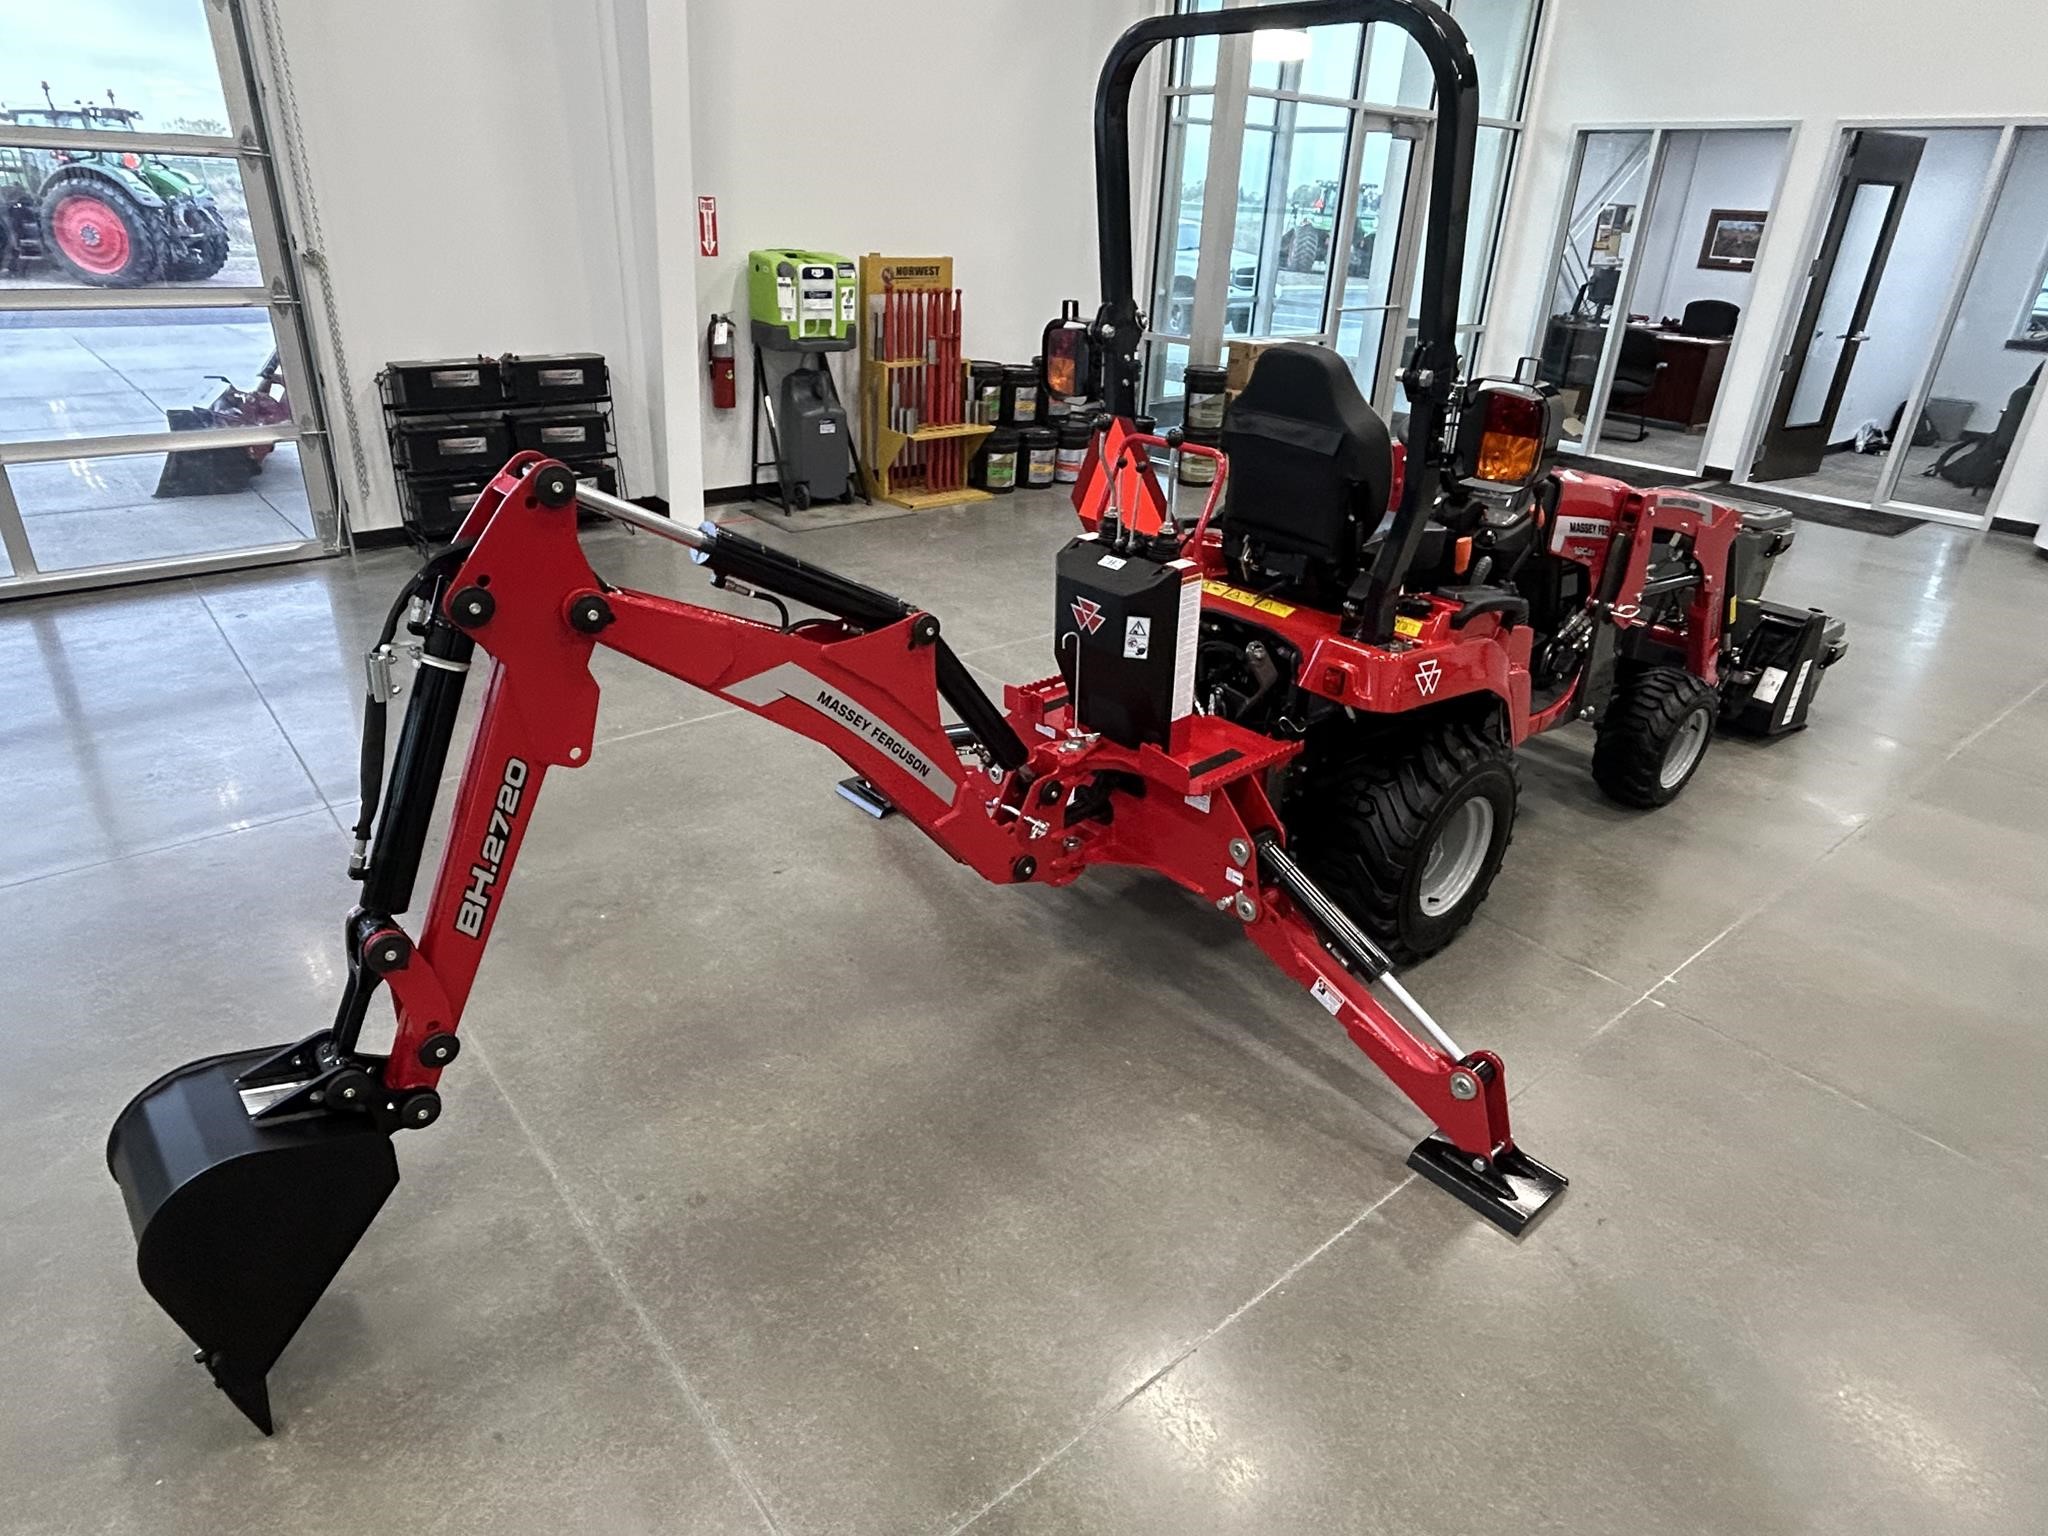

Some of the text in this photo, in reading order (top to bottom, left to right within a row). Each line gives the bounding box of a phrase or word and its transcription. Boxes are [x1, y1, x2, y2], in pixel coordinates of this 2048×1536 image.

[701, 202, 713, 210] FIRE
[896, 266, 940, 276] NORWEST
[1569, 522, 1597, 534] MASSEY
[817, 691, 931, 777] MASSEY FERGUSON
[454, 756, 530, 940] BH.2720
